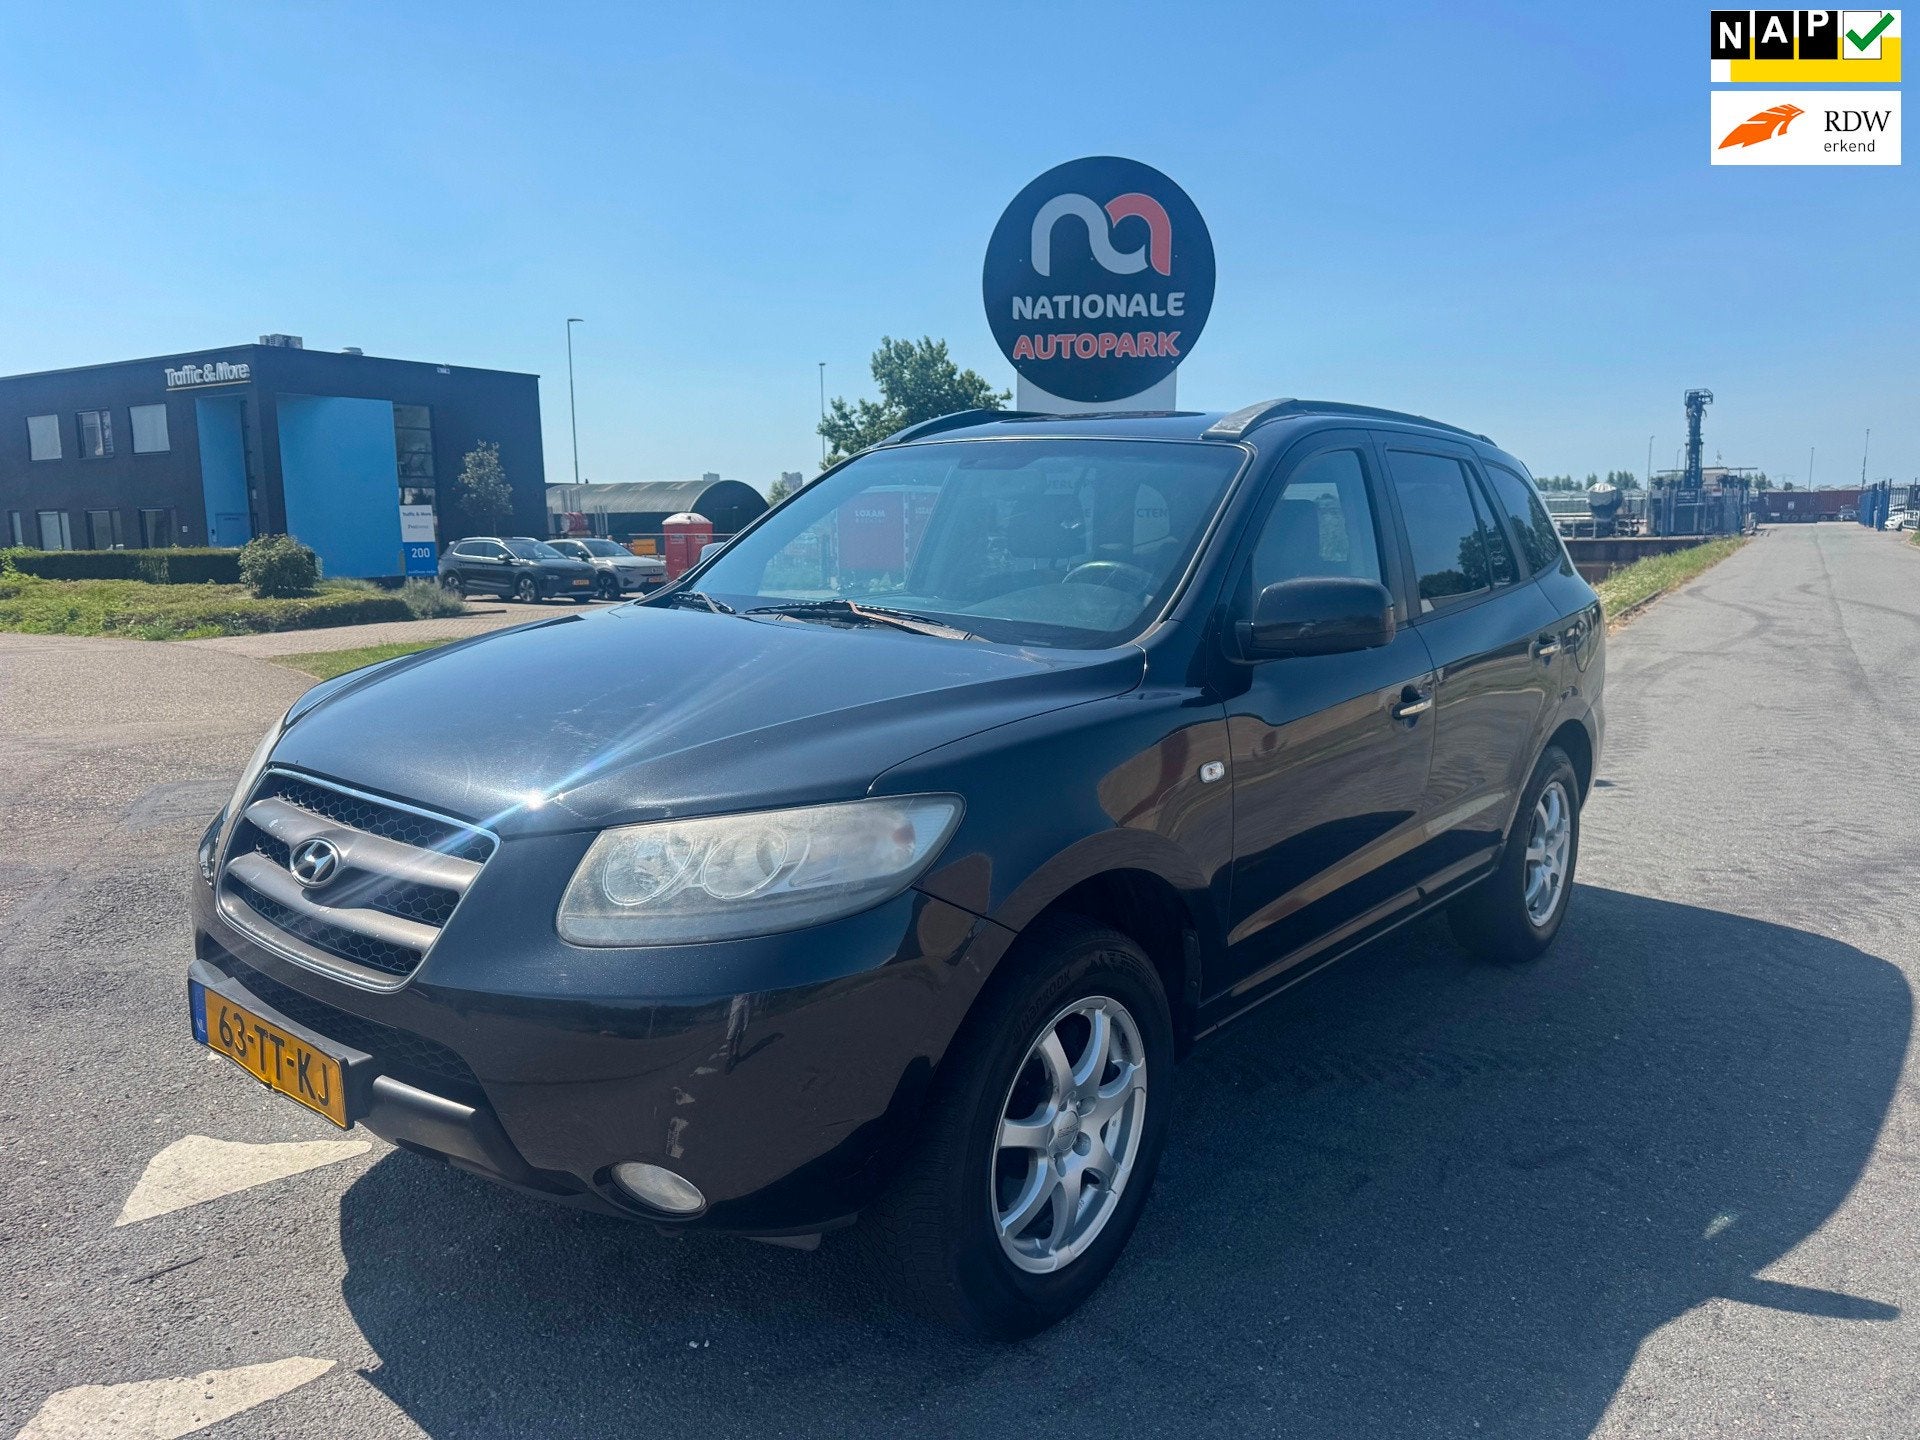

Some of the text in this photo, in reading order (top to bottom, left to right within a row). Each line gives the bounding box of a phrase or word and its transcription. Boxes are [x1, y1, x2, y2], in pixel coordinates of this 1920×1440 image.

[1012, 292, 1186, 320] NATIONALE
[1012, 331, 1181, 360] AUTOPARK
[164, 361, 251, 387] Traffic & More
[411, 547, 431, 558] 200
[218, 1005, 329, 1107] 63-TT-KJ
